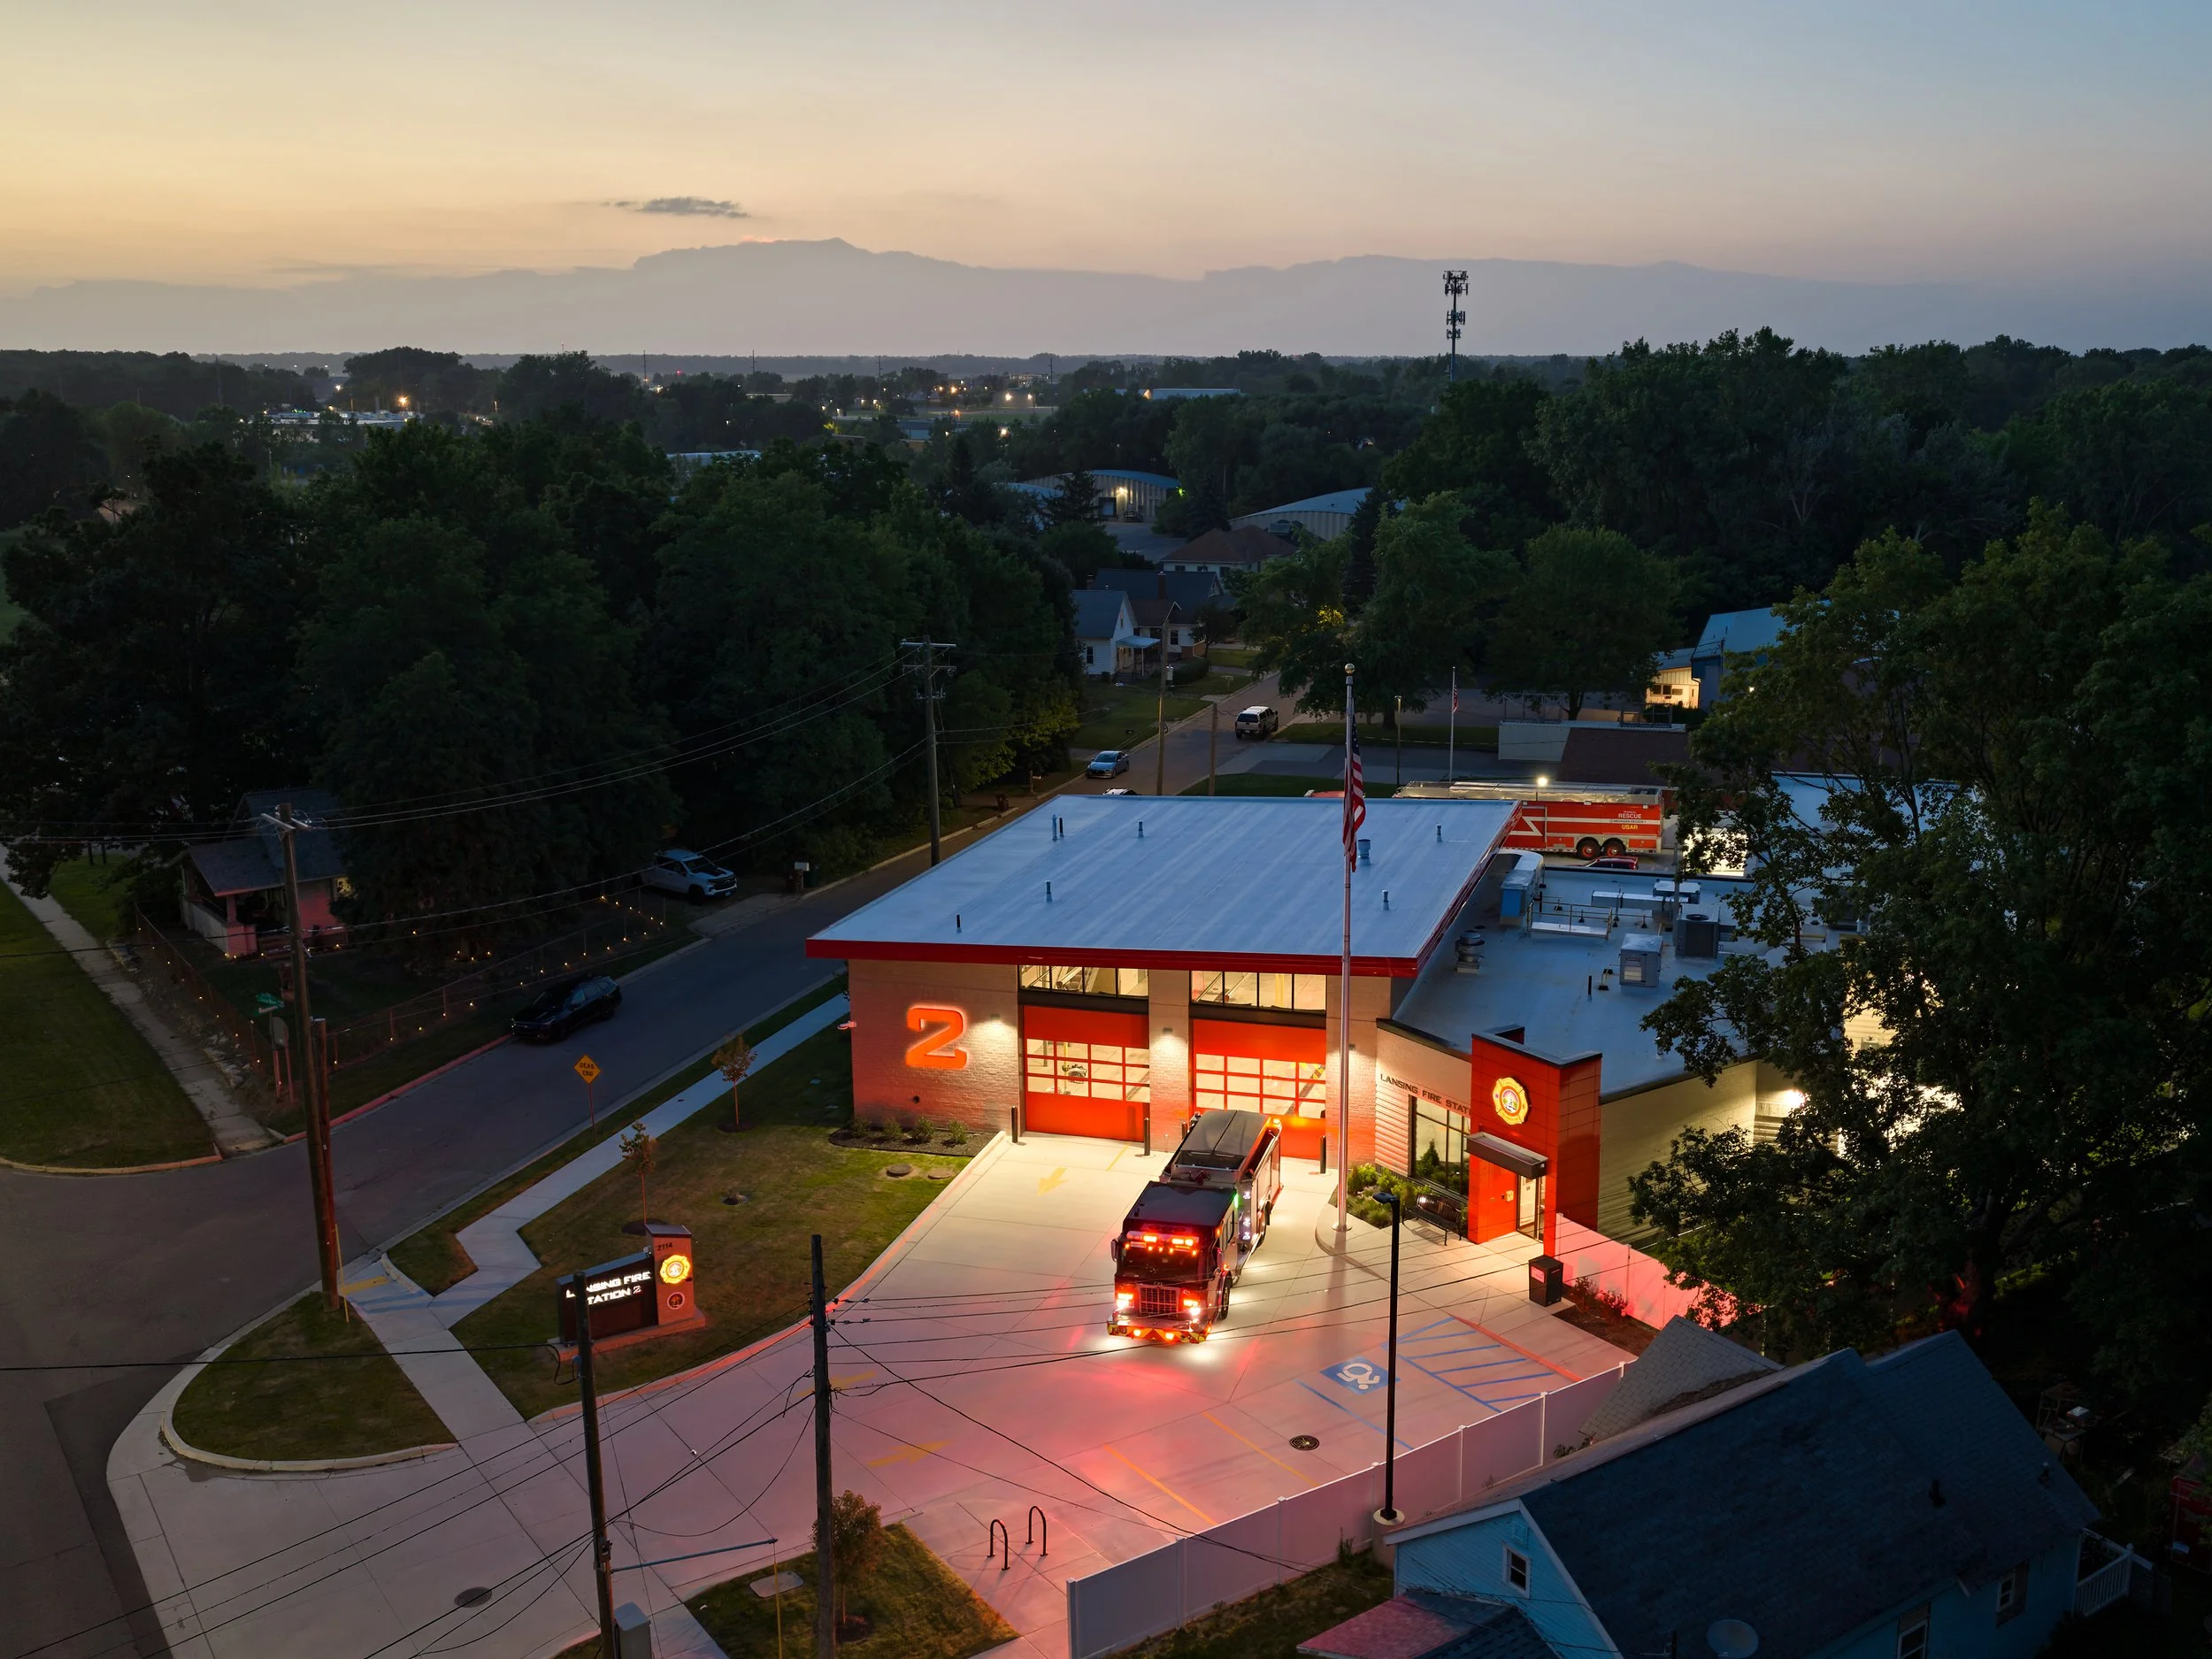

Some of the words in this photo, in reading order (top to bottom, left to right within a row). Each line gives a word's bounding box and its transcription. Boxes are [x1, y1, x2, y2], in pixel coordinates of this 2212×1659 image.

[905, 1007, 968, 1069] 2
[1379, 1072, 1418, 1094] LANSING
[1422, 1089, 1442, 1104] FIRE
[657, 1242, 673, 1251] 2114
[565, 1278, 622, 1299] LNSING
[623, 1271, 652, 1285] FIRE
[587, 1287, 632, 1305] TATION
[633, 1285, 642, 1294] 2
